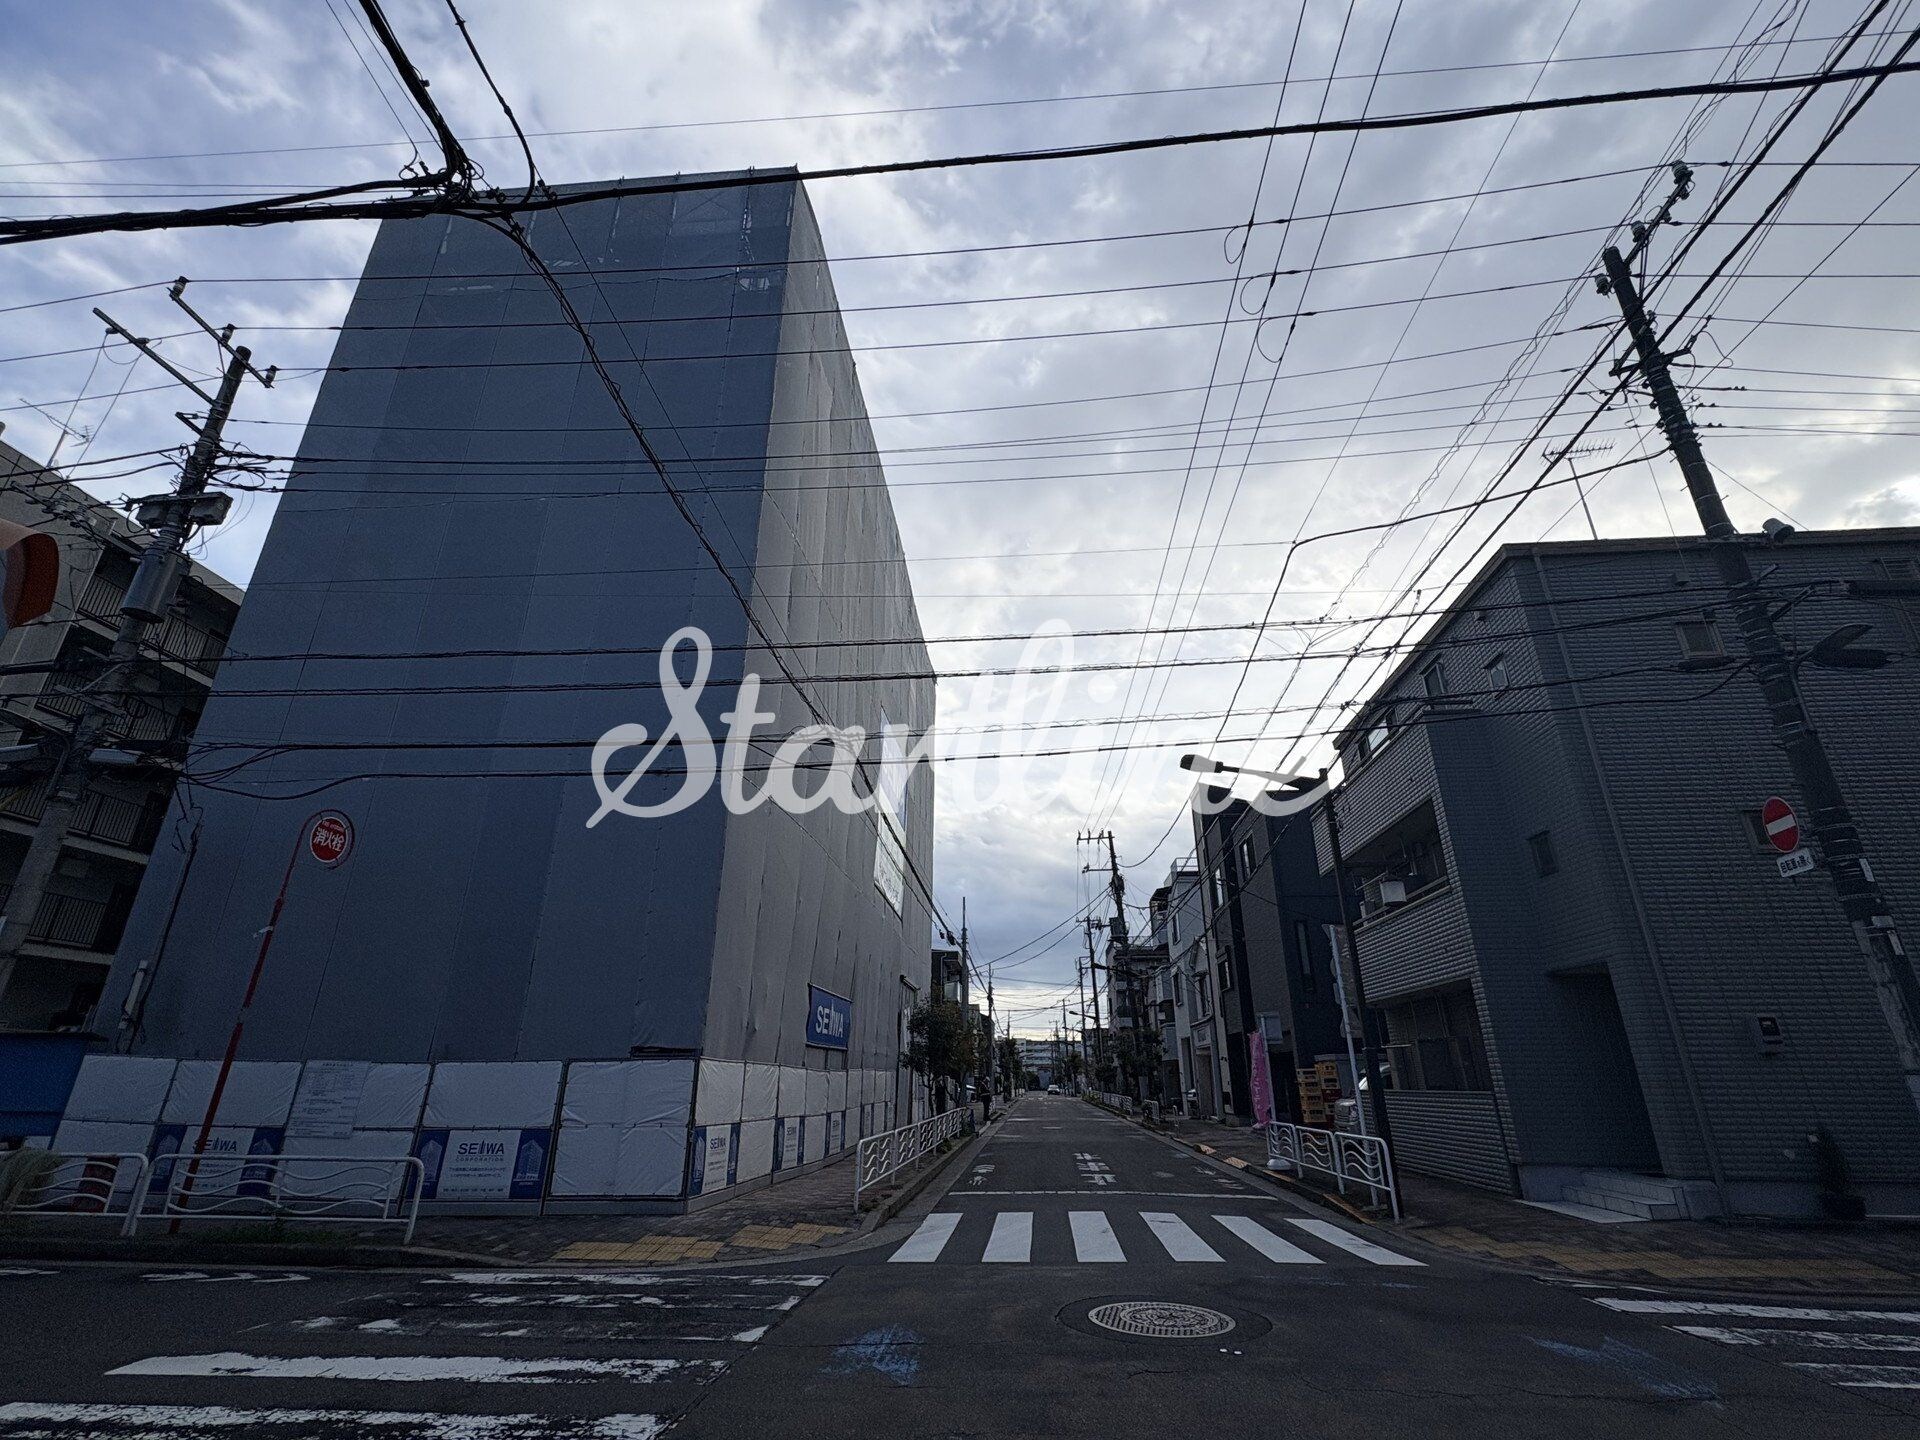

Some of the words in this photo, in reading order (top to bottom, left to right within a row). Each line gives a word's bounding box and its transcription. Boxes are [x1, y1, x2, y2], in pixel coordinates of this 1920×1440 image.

[313, 827, 345, 852] 消火栓
[815, 1001, 844, 1038] SEIWA
[457, 1140, 505, 1155] SEIWA
